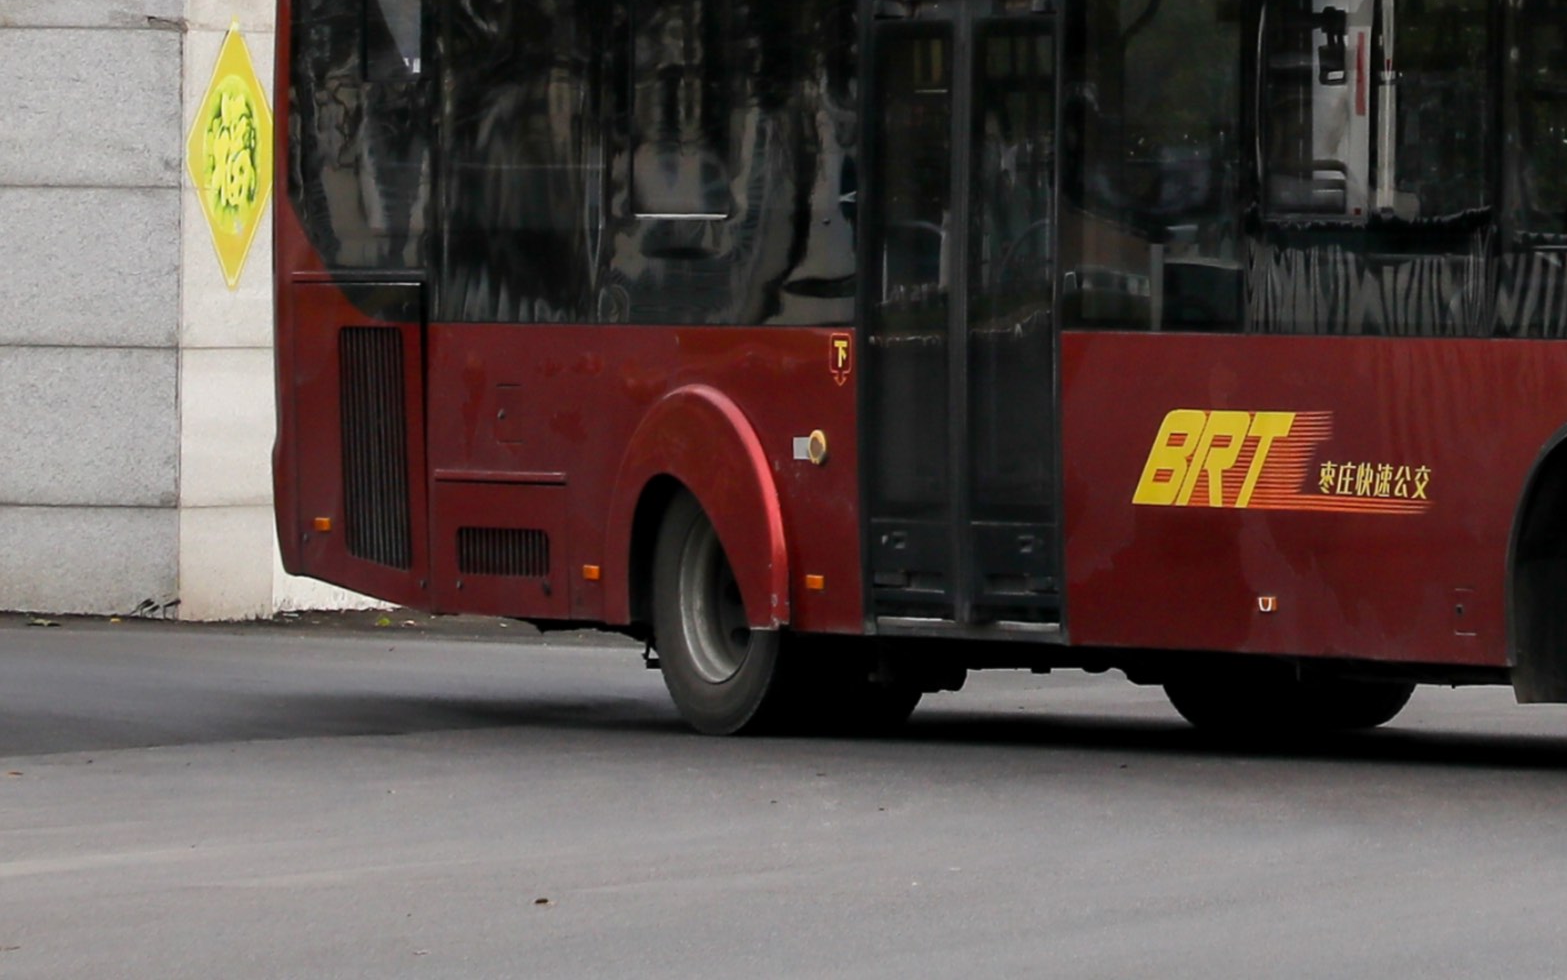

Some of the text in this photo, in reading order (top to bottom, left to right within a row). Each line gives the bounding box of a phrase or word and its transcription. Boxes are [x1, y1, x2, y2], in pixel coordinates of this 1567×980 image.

[834, 340, 848, 368] 下
[1132, 409, 1296, 508] BRT
[1318, 460, 1432, 500] 枣庄快速公交
